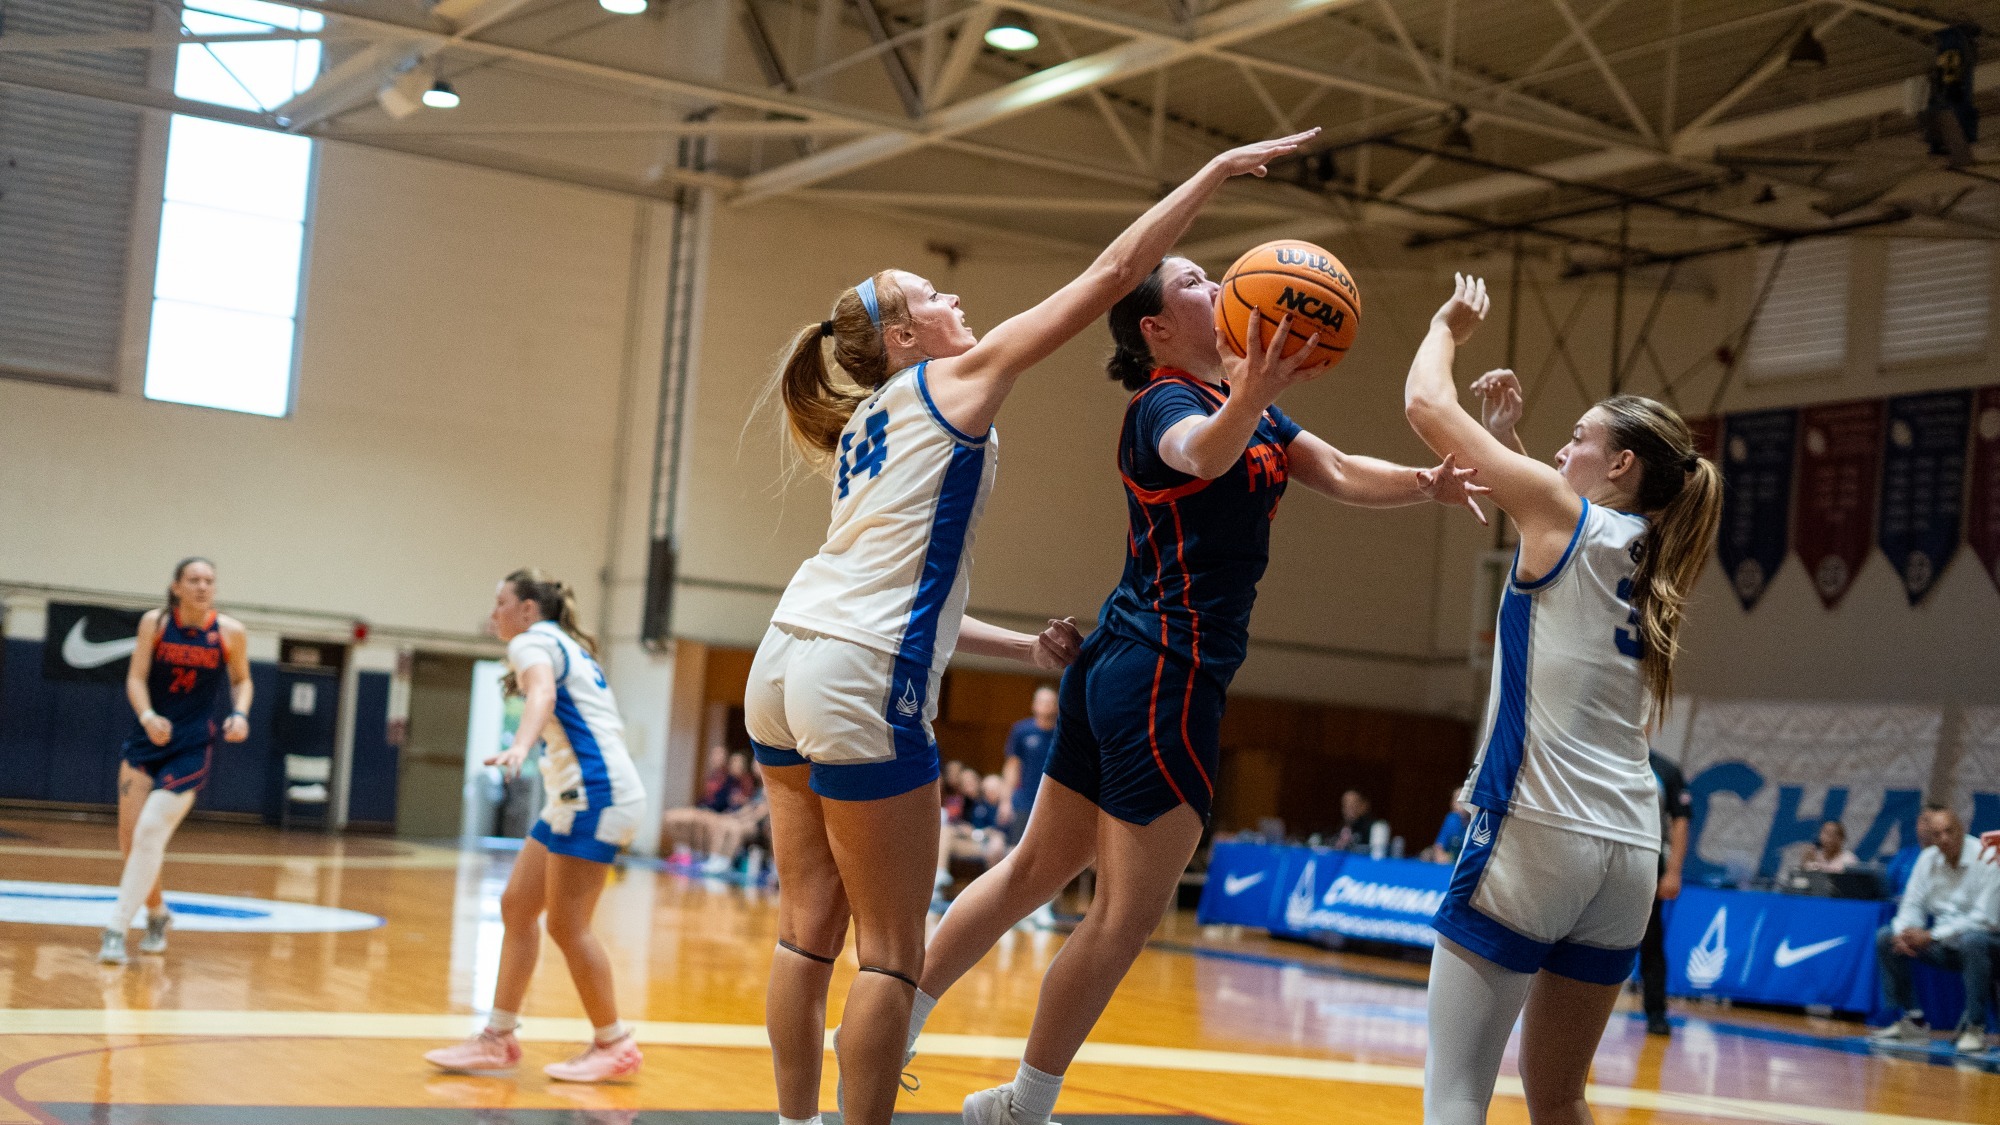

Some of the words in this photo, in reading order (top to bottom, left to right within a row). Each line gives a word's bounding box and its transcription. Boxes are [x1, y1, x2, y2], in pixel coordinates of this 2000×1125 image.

[1274, 248, 1358, 301] Wilson
[1276, 286, 1345, 332] NCAA
[838, 408, 889, 500] 14
[168, 667, 198, 694] 24
